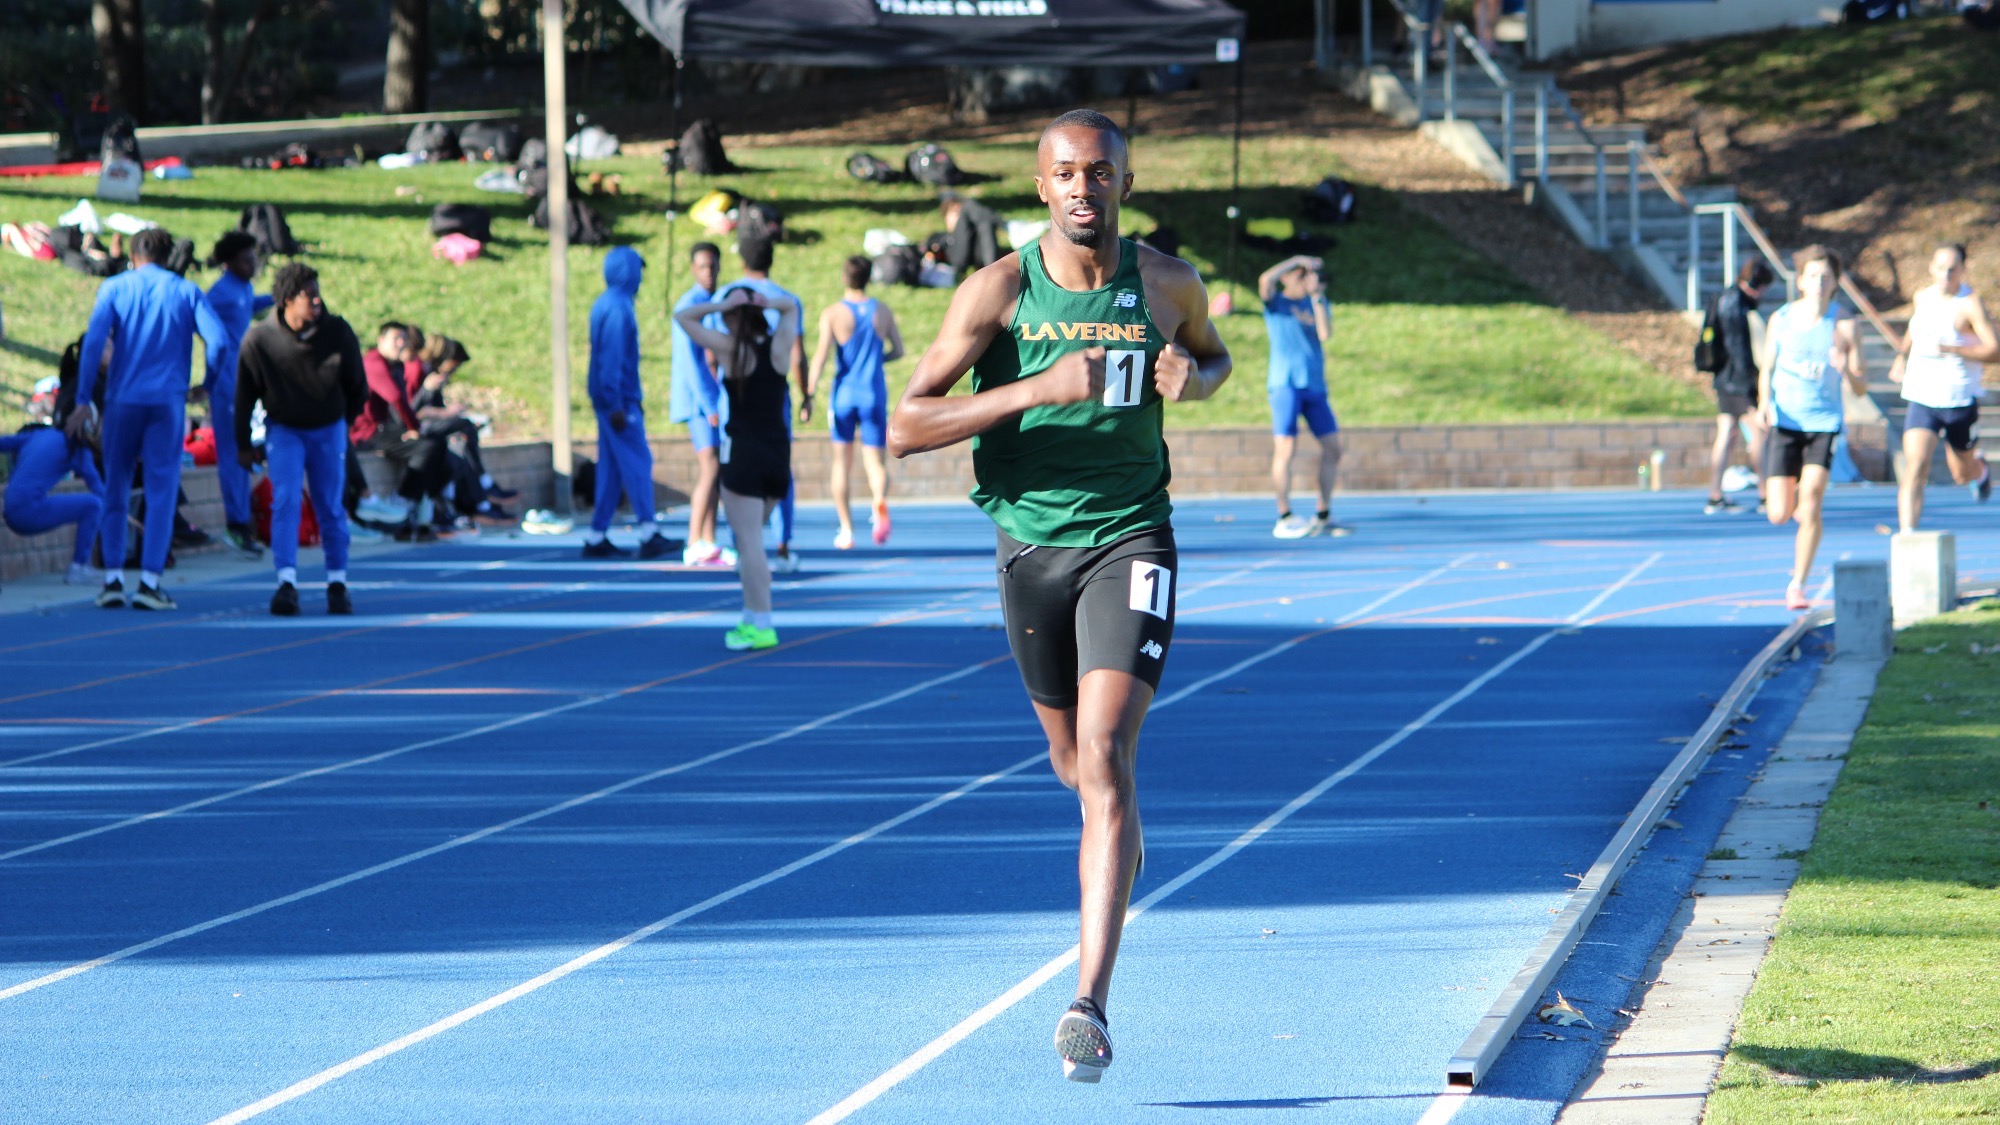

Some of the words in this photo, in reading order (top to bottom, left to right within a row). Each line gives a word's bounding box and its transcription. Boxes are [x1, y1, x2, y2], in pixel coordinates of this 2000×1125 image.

[876, 0, 955, 15] TRACK
[956, 0, 977, 15] &
[977, 0, 1047, 15] FIELD
[1117, 354, 1134, 403] 1
[1144, 568, 1160, 612] 1
